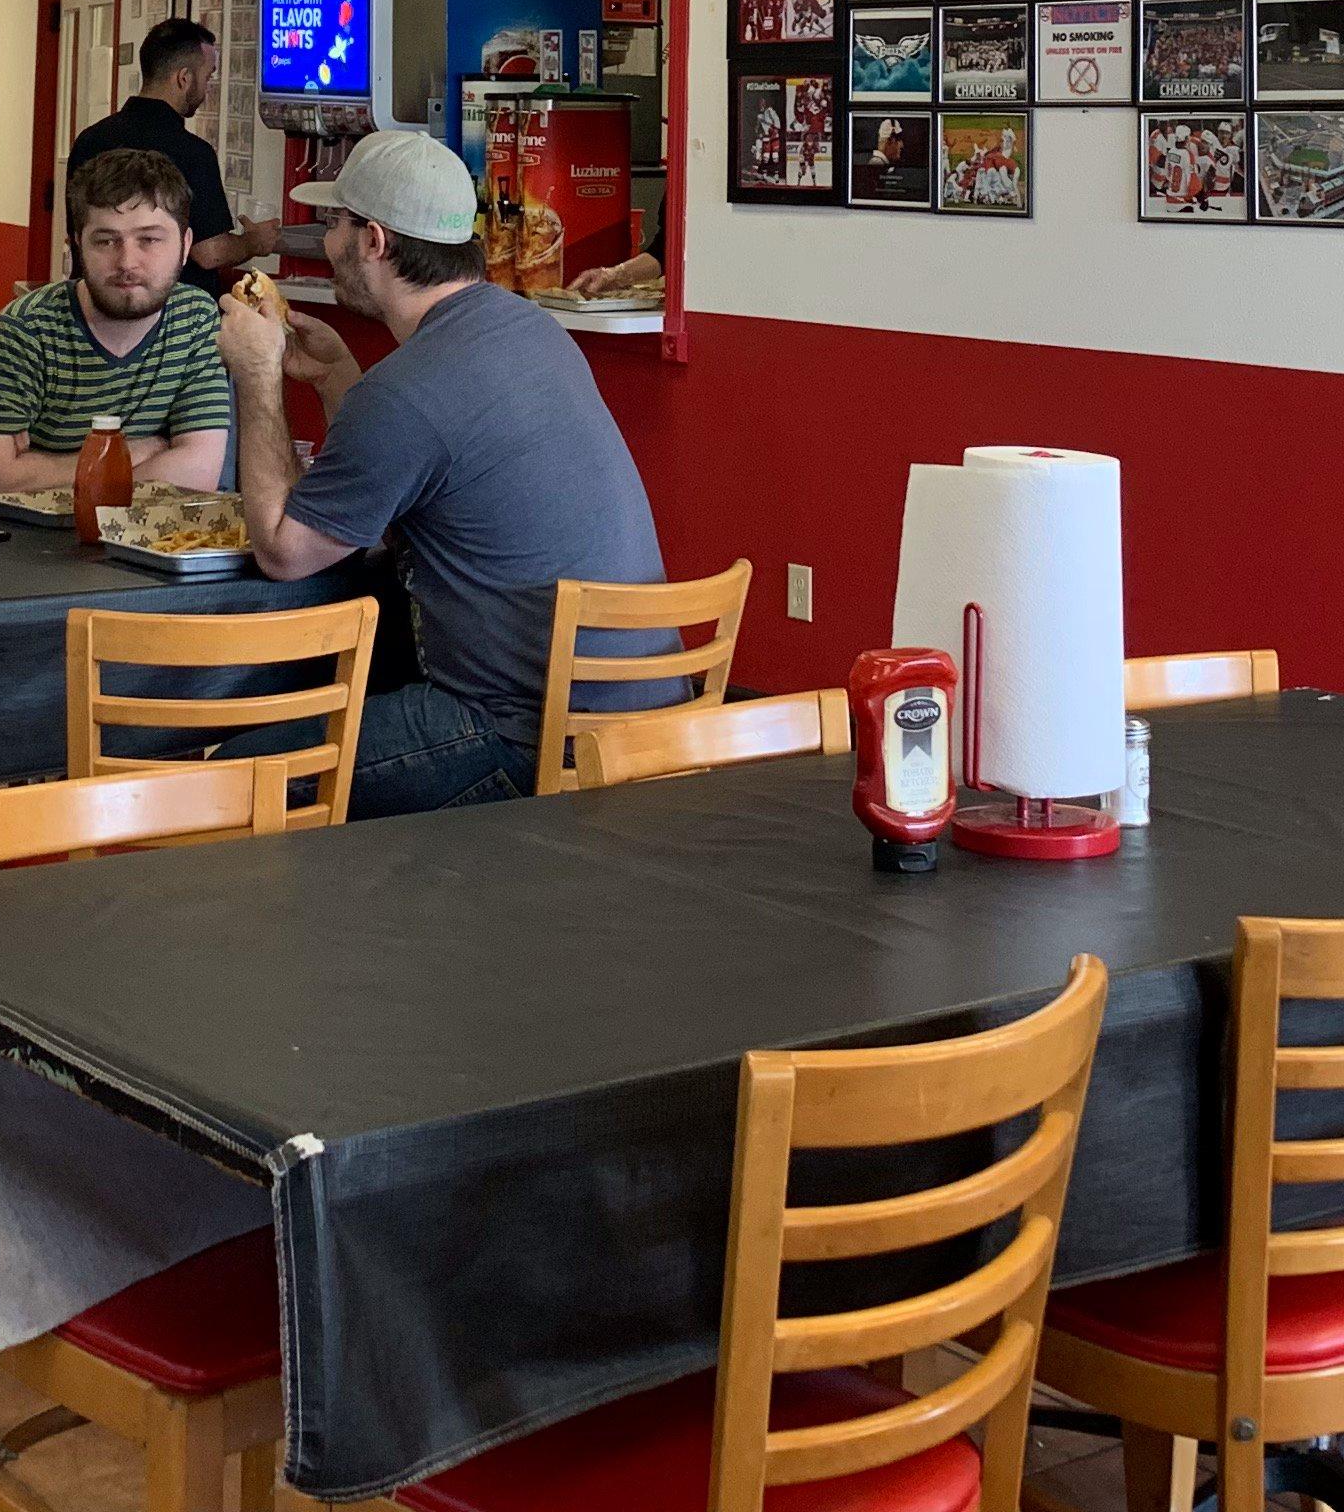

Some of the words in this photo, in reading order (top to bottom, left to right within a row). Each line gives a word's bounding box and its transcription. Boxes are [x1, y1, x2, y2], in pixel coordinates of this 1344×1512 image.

[272, 8, 321, 27] FLAVOR
[1052, 33, 1067, 42] NO
[1069, 31, 1114, 42] SMOKING
[1045, 48, 1070, 56] UNLESS
[1109, 46, 1122, 54] FIRE
[956, 85, 1017, 98] CHAMPIONS
[1159, 82, 1225, 98] CHAMPIONS
[570, 164, 621, 178] Luzianne
[896, 707, 939, 722] CROWN
